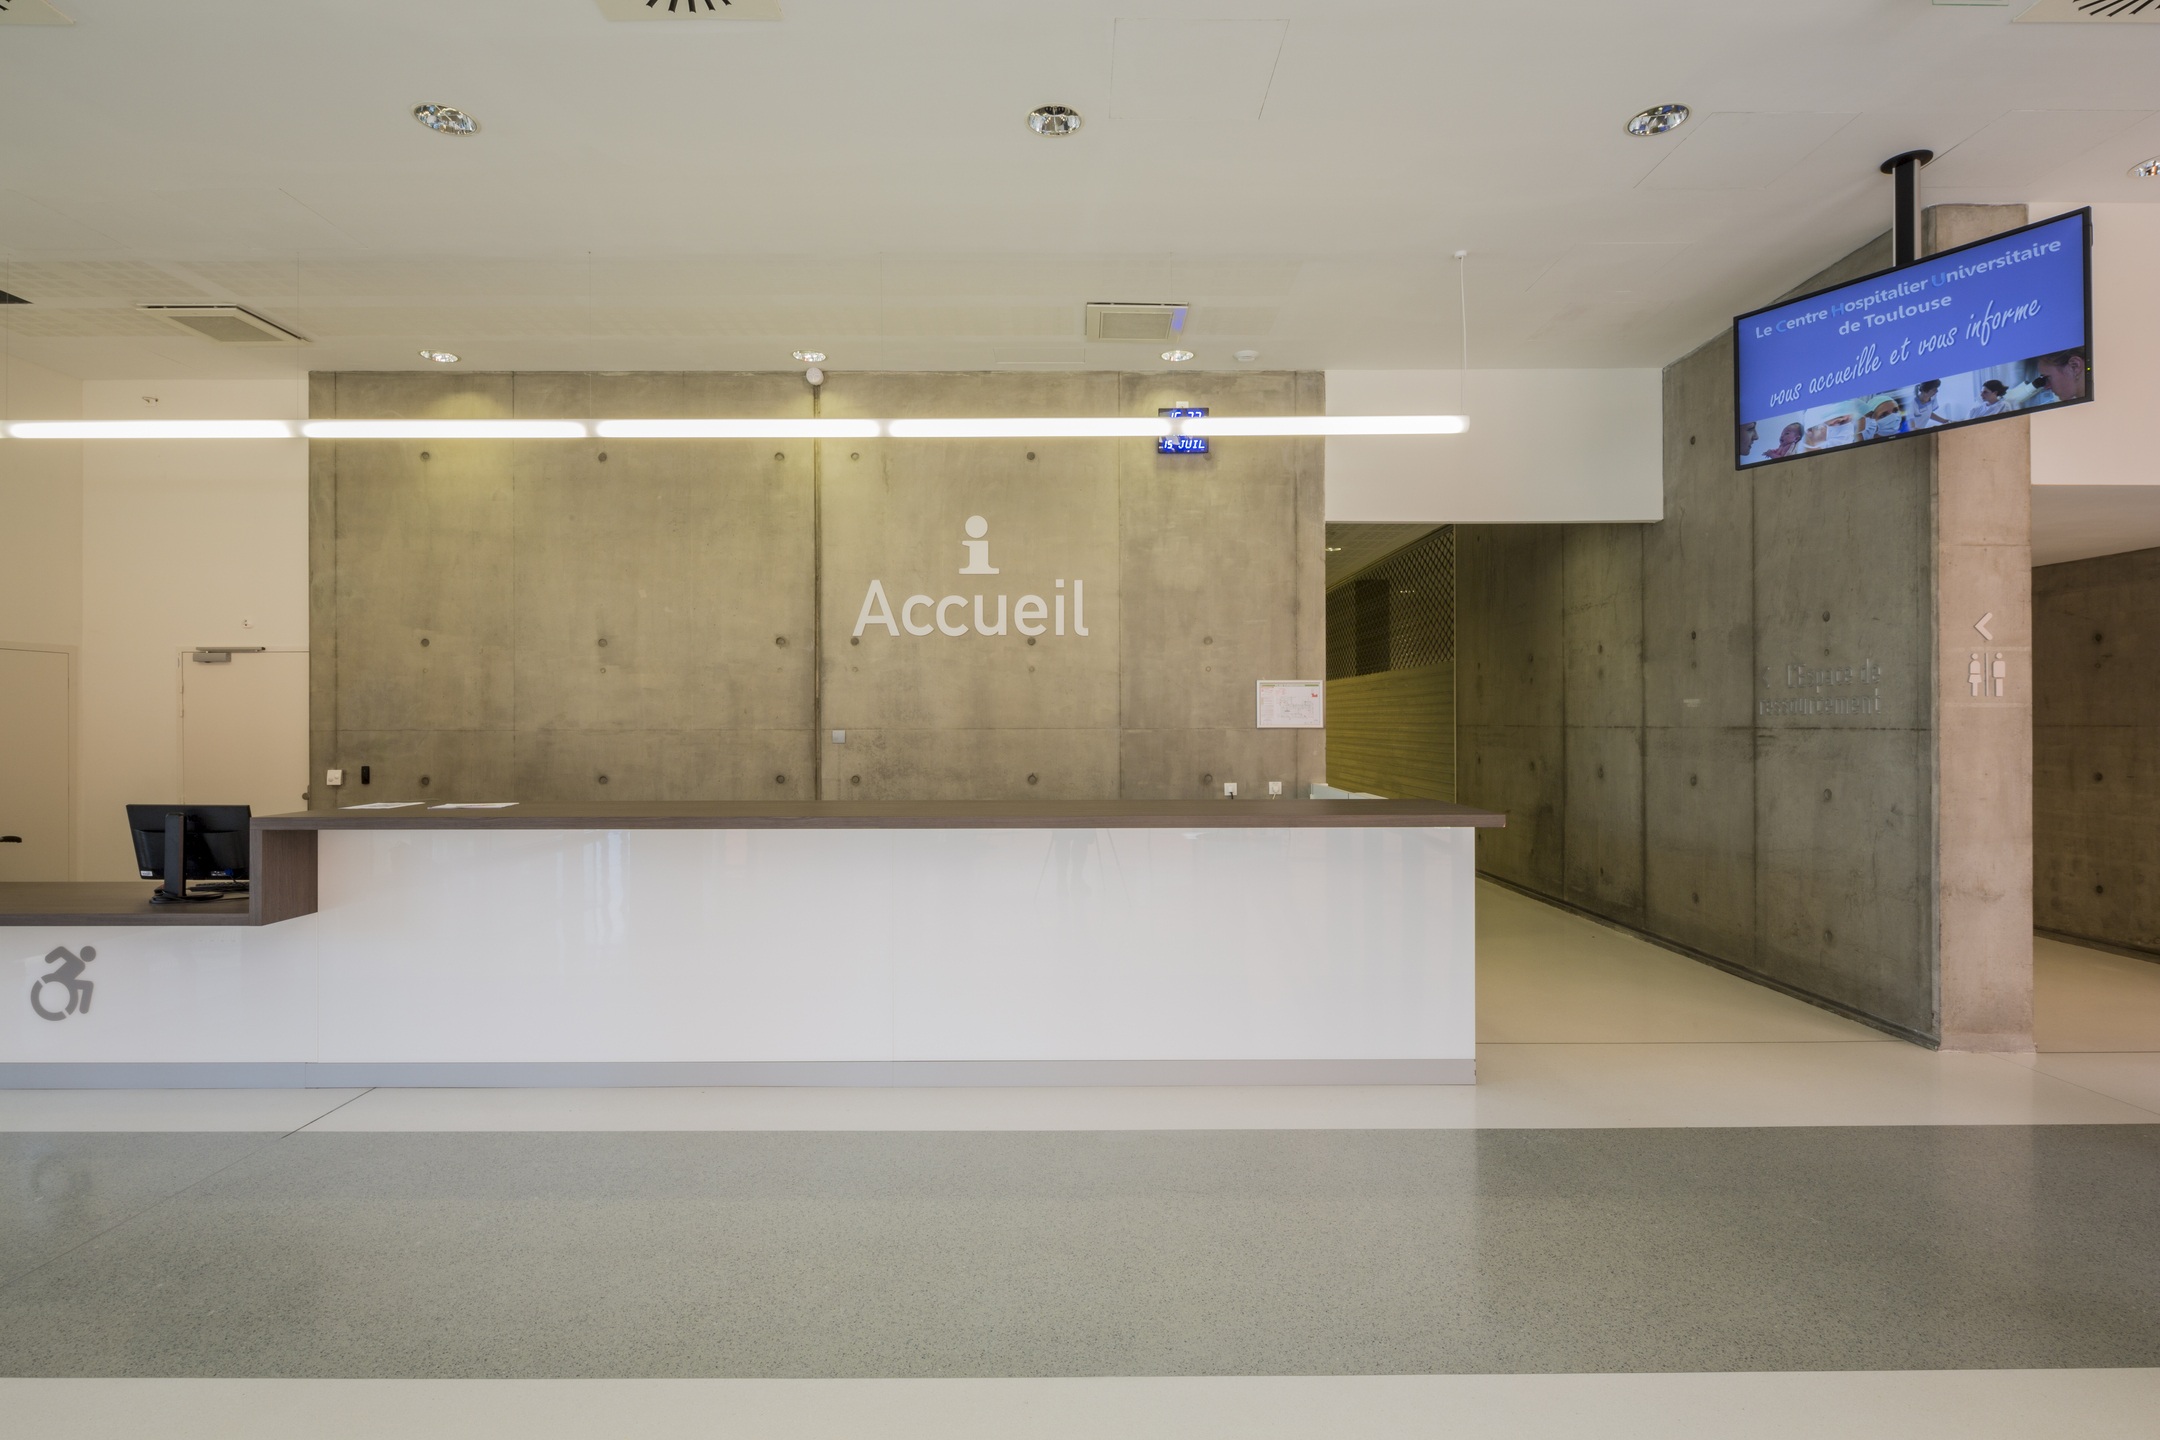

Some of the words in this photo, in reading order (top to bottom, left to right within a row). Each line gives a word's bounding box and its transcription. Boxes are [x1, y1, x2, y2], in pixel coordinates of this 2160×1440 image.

[1756, 325, 1772, 339] Le
[1776, 308, 1828, 333] Centre
[1831, 278, 1928, 317] Hospitalier
[1931, 239, 2061, 287] Universitaire
[1838, 320, 1860, 336] de
[1864, 296, 1952, 328] Toulouse
[1770, 382, 1802, 408] vous
[1809, 344, 1881, 394] accueille
[1890, 340, 1911, 365] et
[1918, 327, 1957, 356] vous
[1965, 299, 2042, 346] informe
[1178, 439, 1205, 449] JUIL
[852, 579, 1089, 637] Accueil
[1860, 657, 1881, 685] de
[1760, 687, 1881, 716] ressourcement
